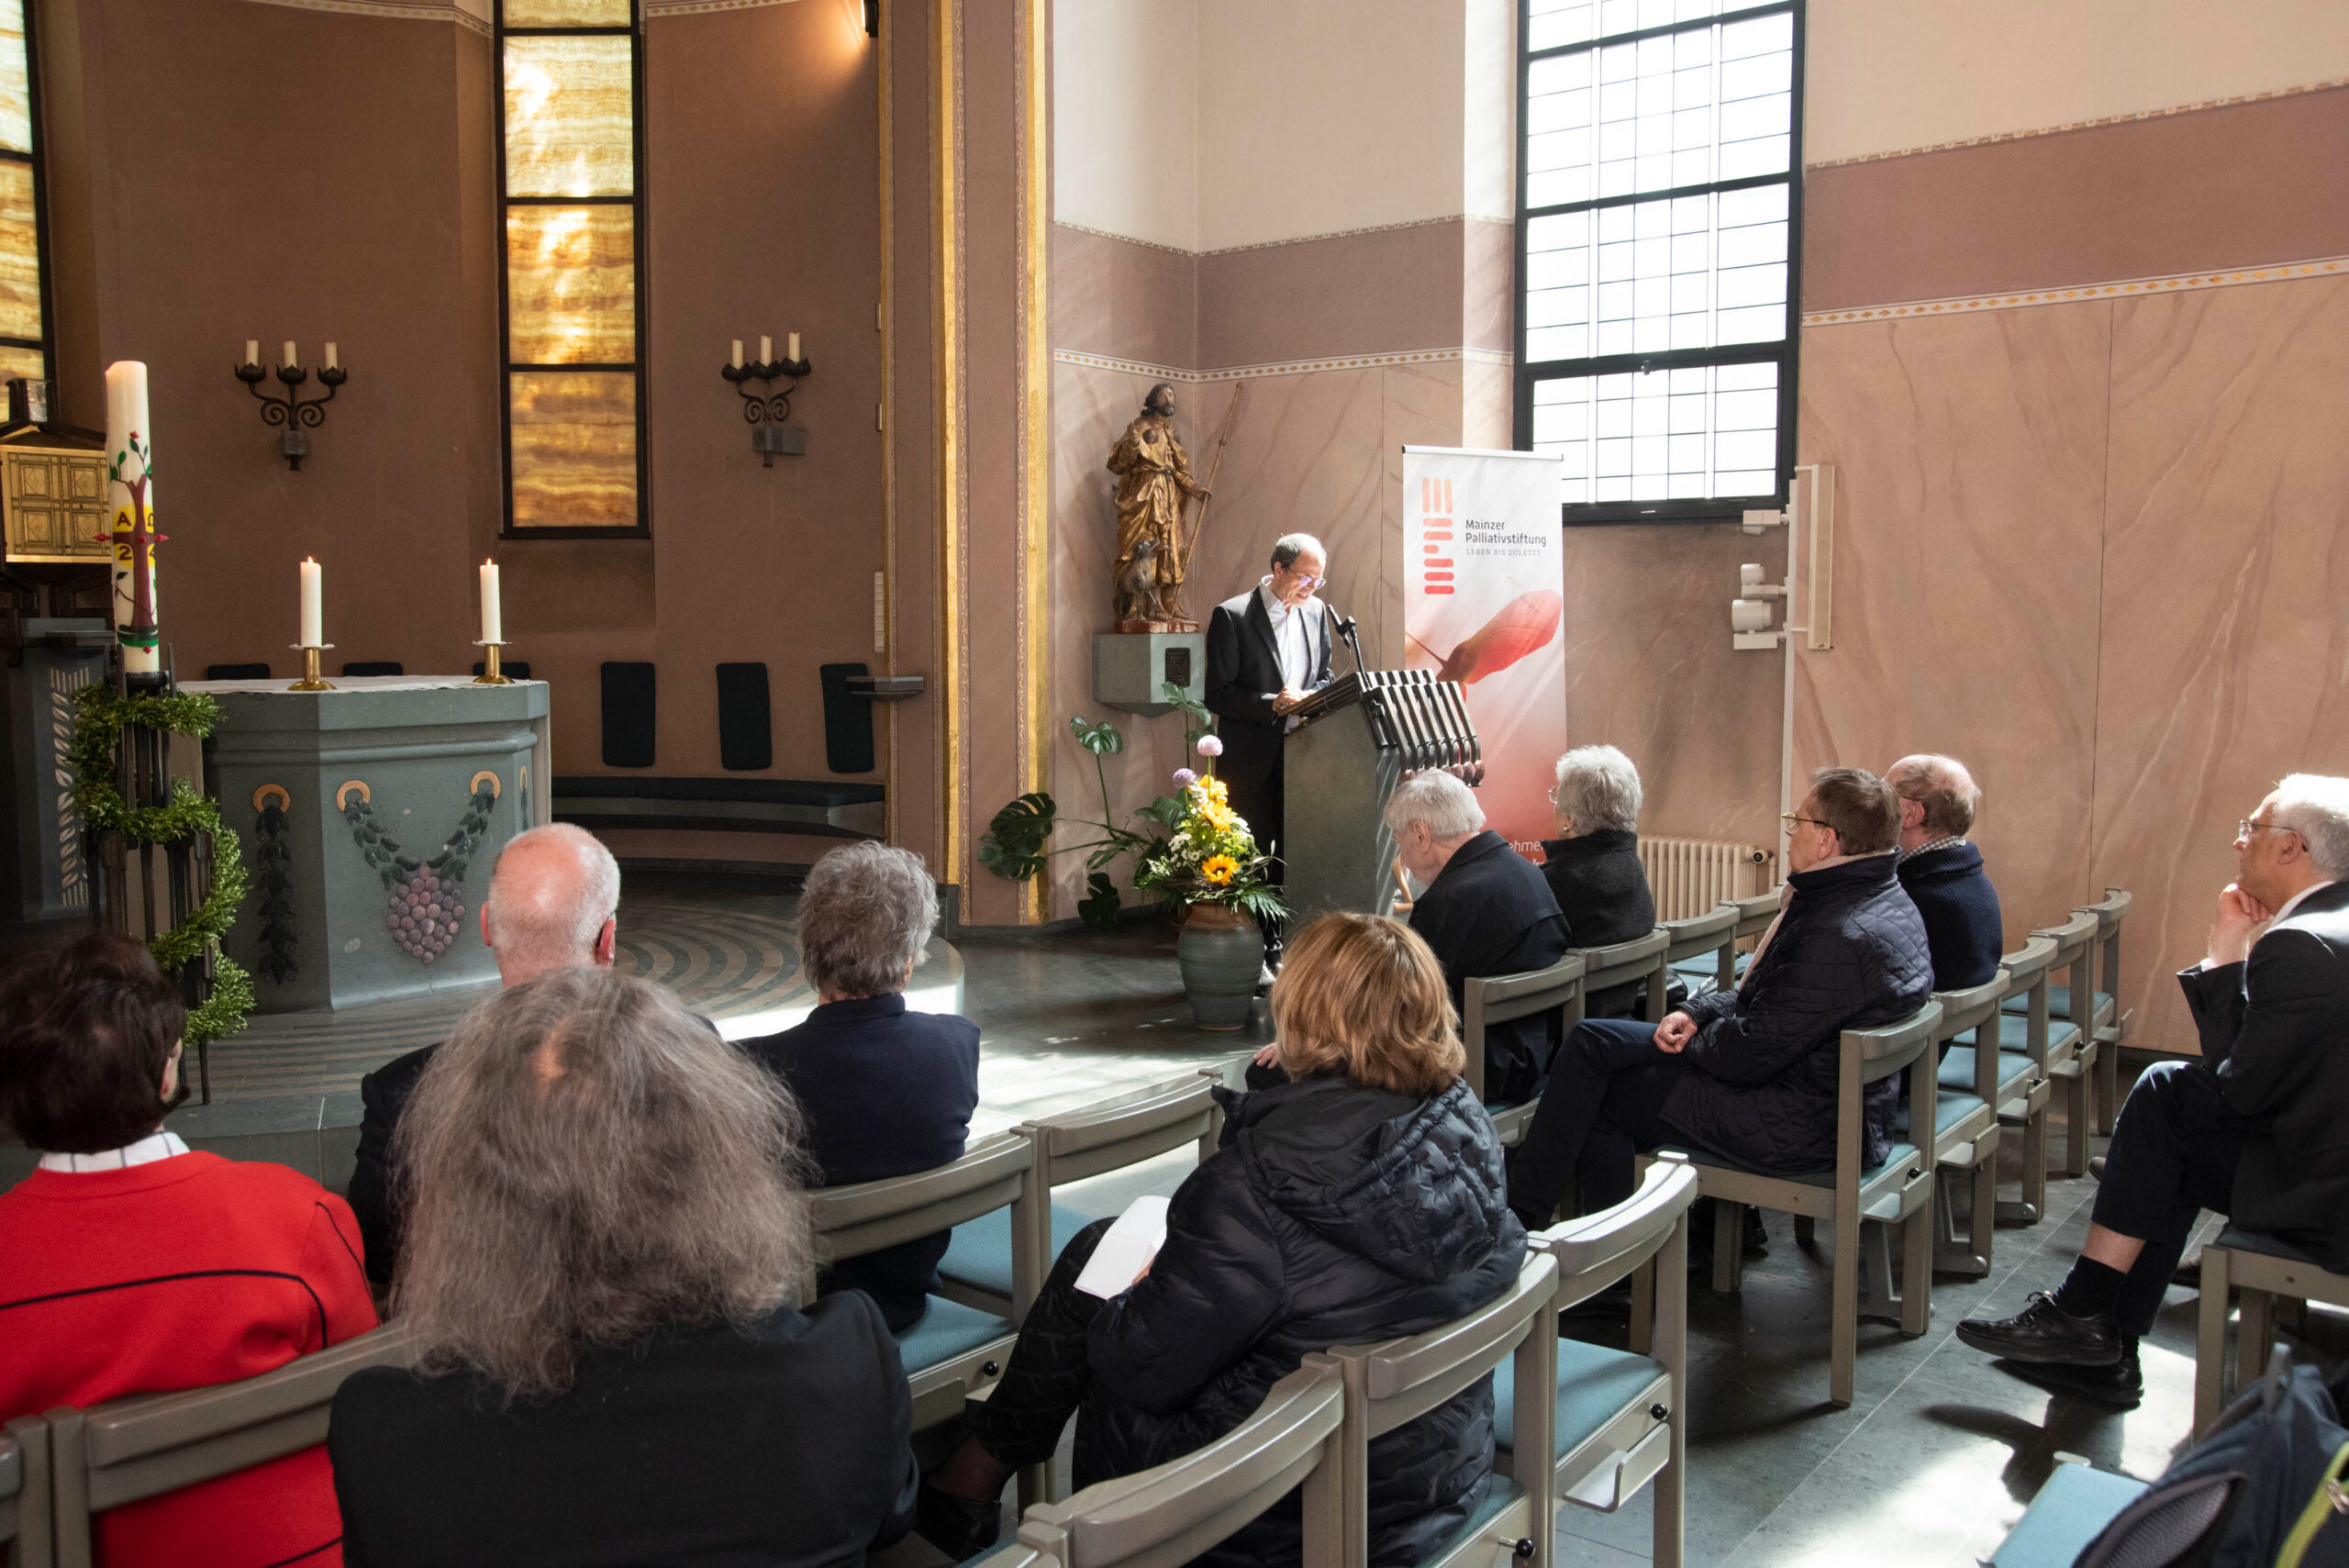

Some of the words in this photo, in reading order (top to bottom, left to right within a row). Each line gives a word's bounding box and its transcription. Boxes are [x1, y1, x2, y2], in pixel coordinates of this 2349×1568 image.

[1465, 519, 1505, 529] Mainzer
[1465, 532, 1546, 547] Palliativstiftung
[118, 545, 132, 561] 2
